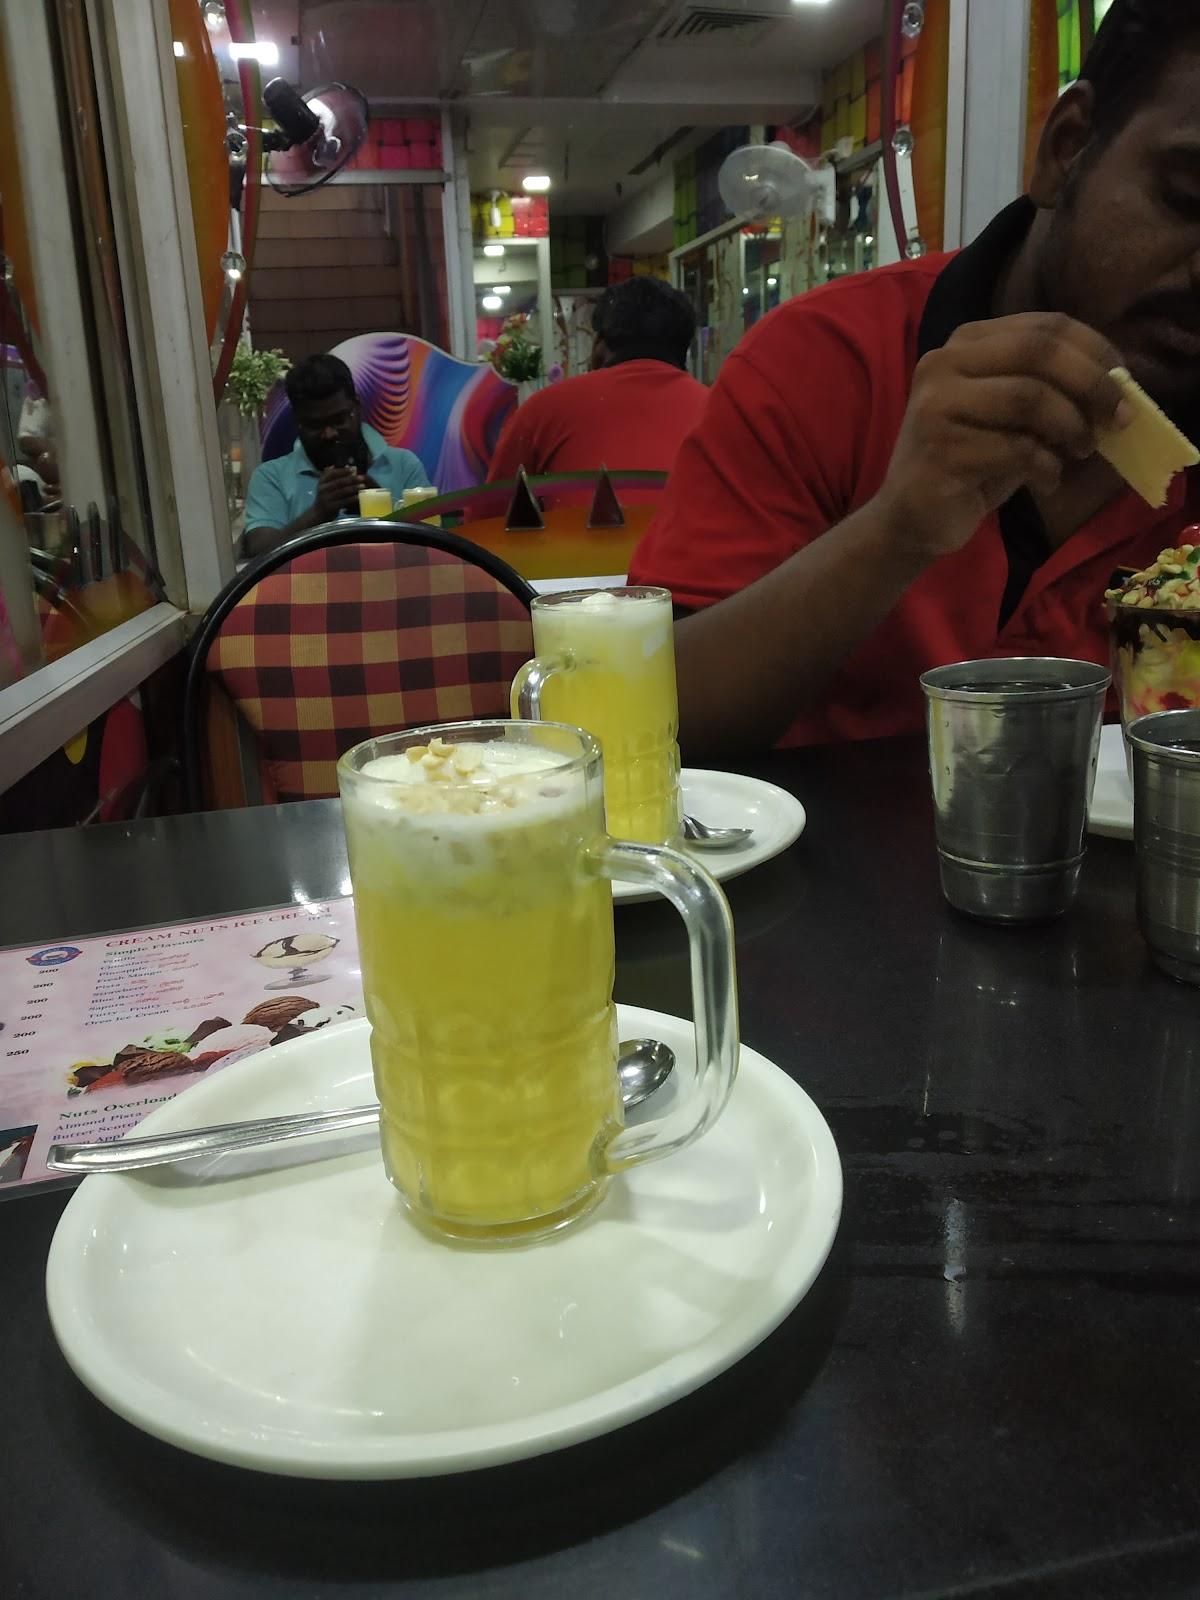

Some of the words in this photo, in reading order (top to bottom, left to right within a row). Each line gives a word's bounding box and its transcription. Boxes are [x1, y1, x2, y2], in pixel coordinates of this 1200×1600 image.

[106, 933, 171, 947] CREAM
[179, 924, 228, 937] NUTS
[234, 918, 264, 927] ICE
[105, 948, 149, 957] Simple
[153, 939, 205, 950] Flavours
[100, 960, 151, 970] Chocolate
[99, 967, 147, 976] Pineapple
[128, 970, 162, 979] Mango
[93, 985, 149, 997] Strawberry
[136, 1010, 169, 1018] Cream
[6, 1049, 30, 1057] 250
[59, 1110, 98, 1120] Nuts
[103, 1093, 177, 1112] Overload
[55, 1118, 106, 1131] Almond
[111, 1112, 142, 1121] Pista
[53, 1130, 96, 1141] Butter
